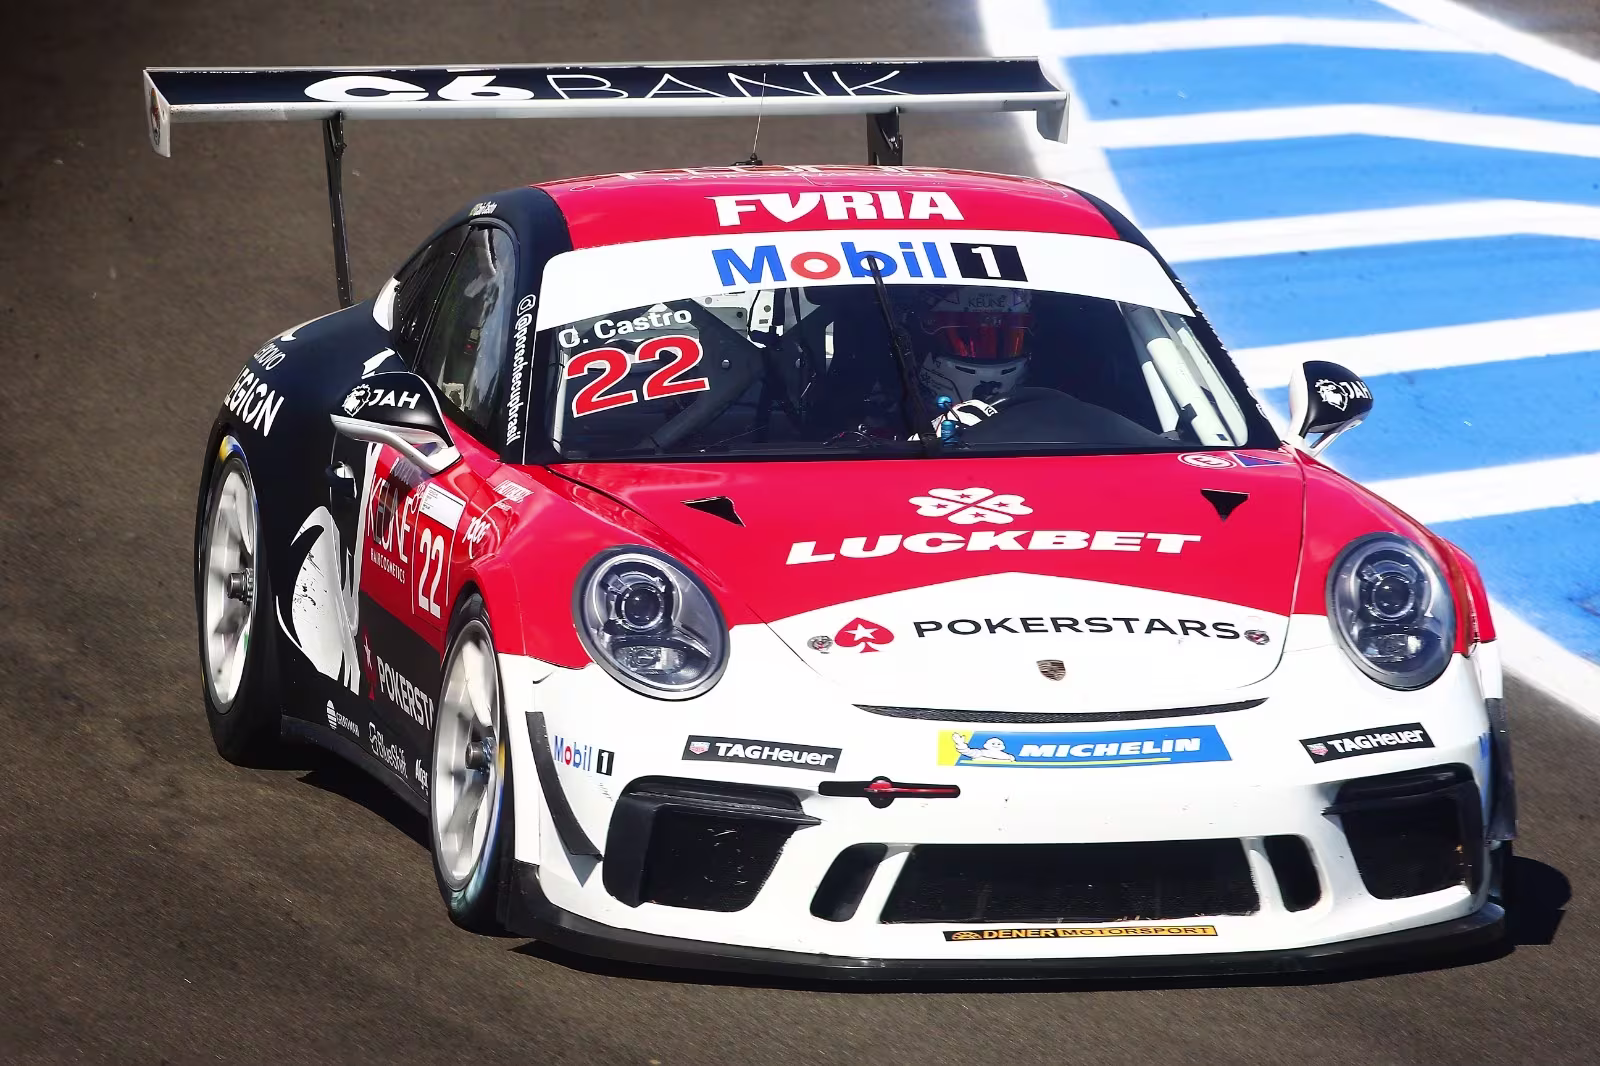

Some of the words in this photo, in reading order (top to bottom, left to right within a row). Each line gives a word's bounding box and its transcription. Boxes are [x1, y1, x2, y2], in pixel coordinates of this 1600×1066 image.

[304, 75, 535, 102] C6
[546, 70, 911, 99] BANK
[711, 242, 947, 287] Mobil
[594, 309, 692, 340] Castro
[564, 334, 711, 419] 22
[1339, 381, 1373, 400] JAH
[368, 388, 421, 410] JAH
[785, 530, 1202, 565] LUCKBET
[370, 547, 406, 584] HAIRCOSMETICS
[418, 527, 445, 619] 22
[913, 616, 1241, 641] POKERSTARS
[554, 735, 592, 772] Mobil
[1018, 737, 1201, 759] MICHELIN
[983, 929, 1055, 939] DENER
[1062, 926, 1210, 937] MOTORSPORT
